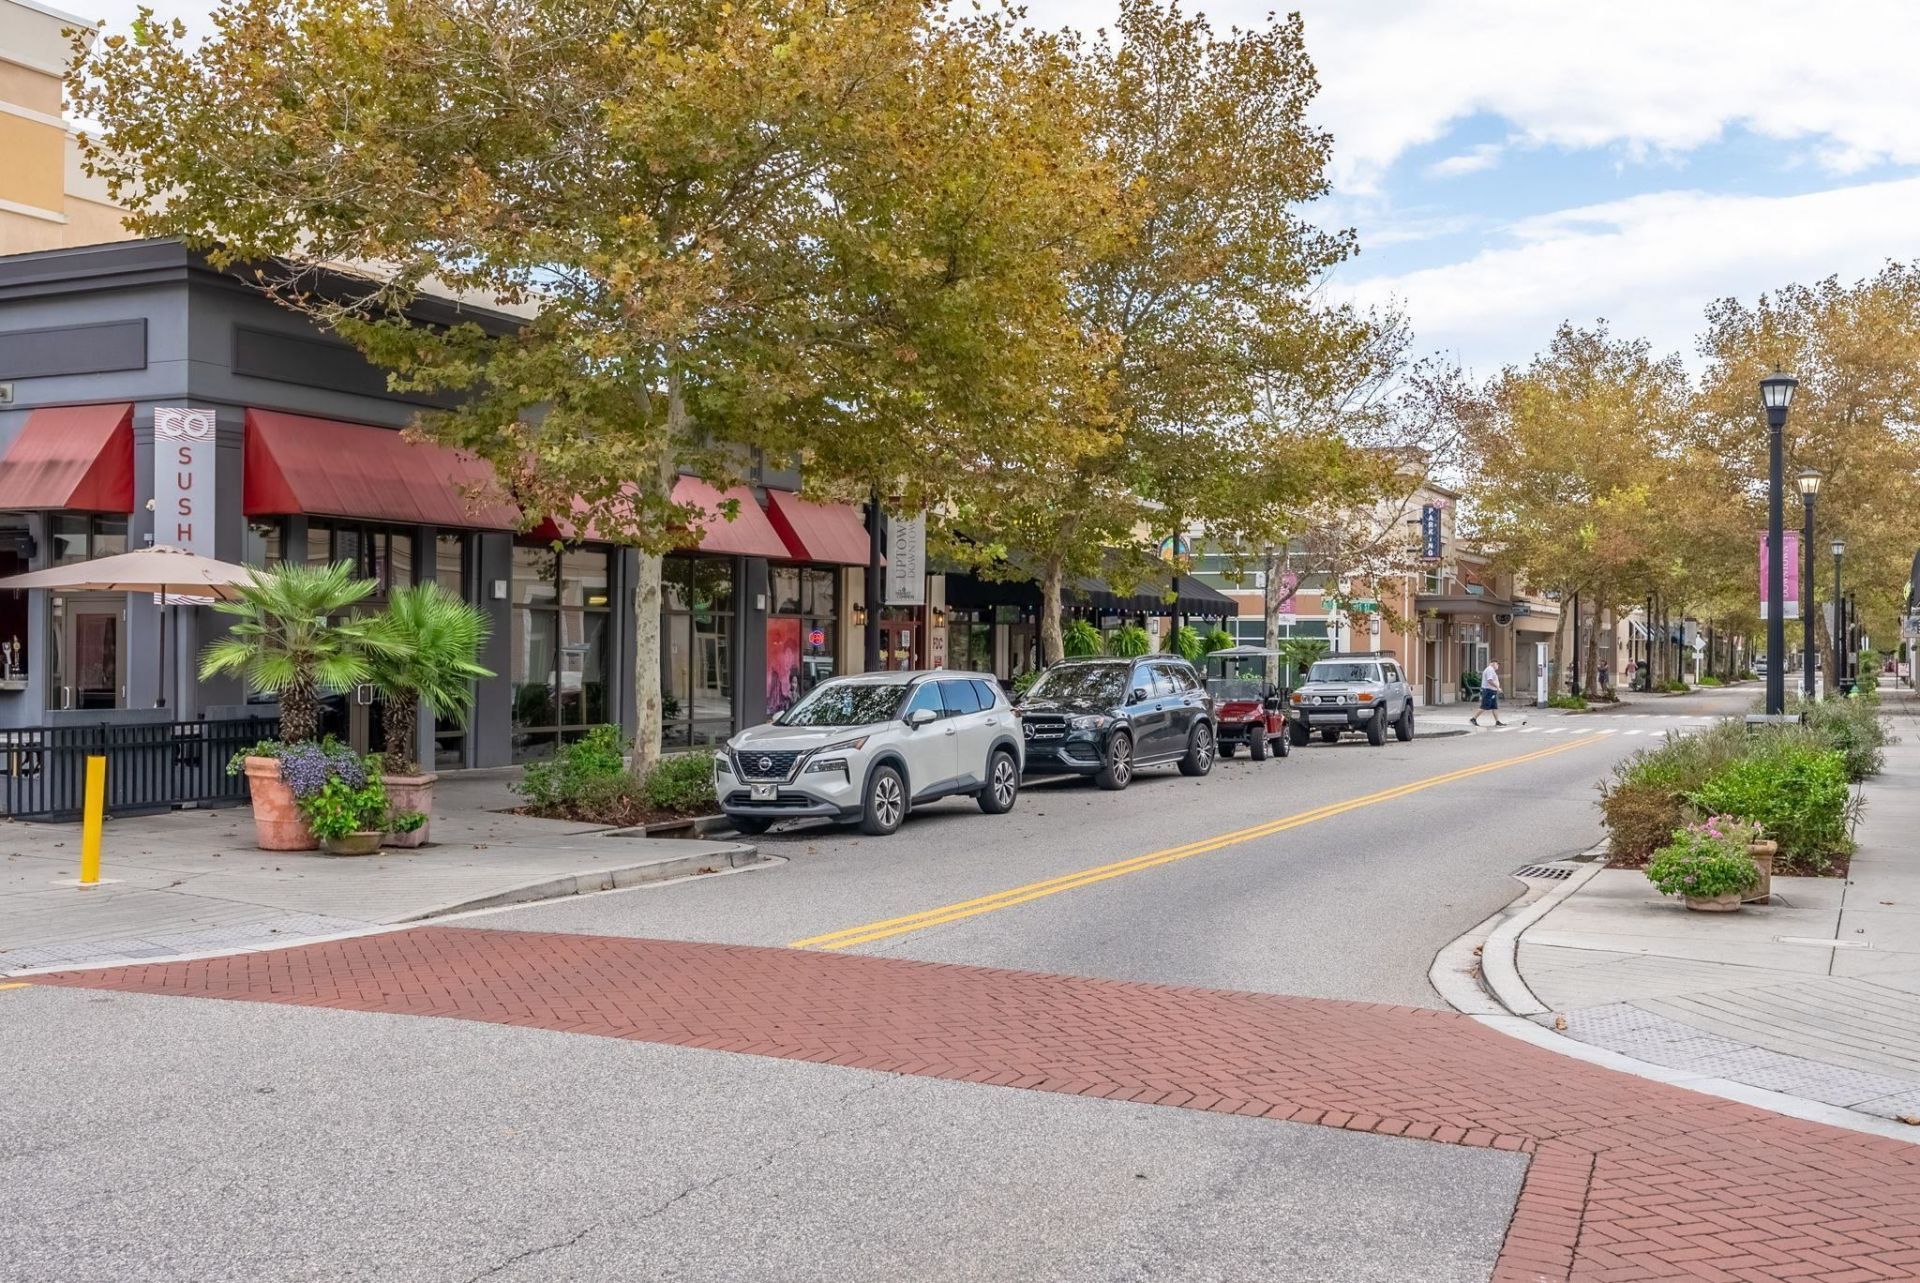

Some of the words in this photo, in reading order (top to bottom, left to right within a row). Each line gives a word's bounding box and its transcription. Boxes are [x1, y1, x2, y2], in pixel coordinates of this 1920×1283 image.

[161, 413, 209, 437] CO
[177, 446, 192, 551] SUSH
[907, 522, 916, 578] DOWNTOW
